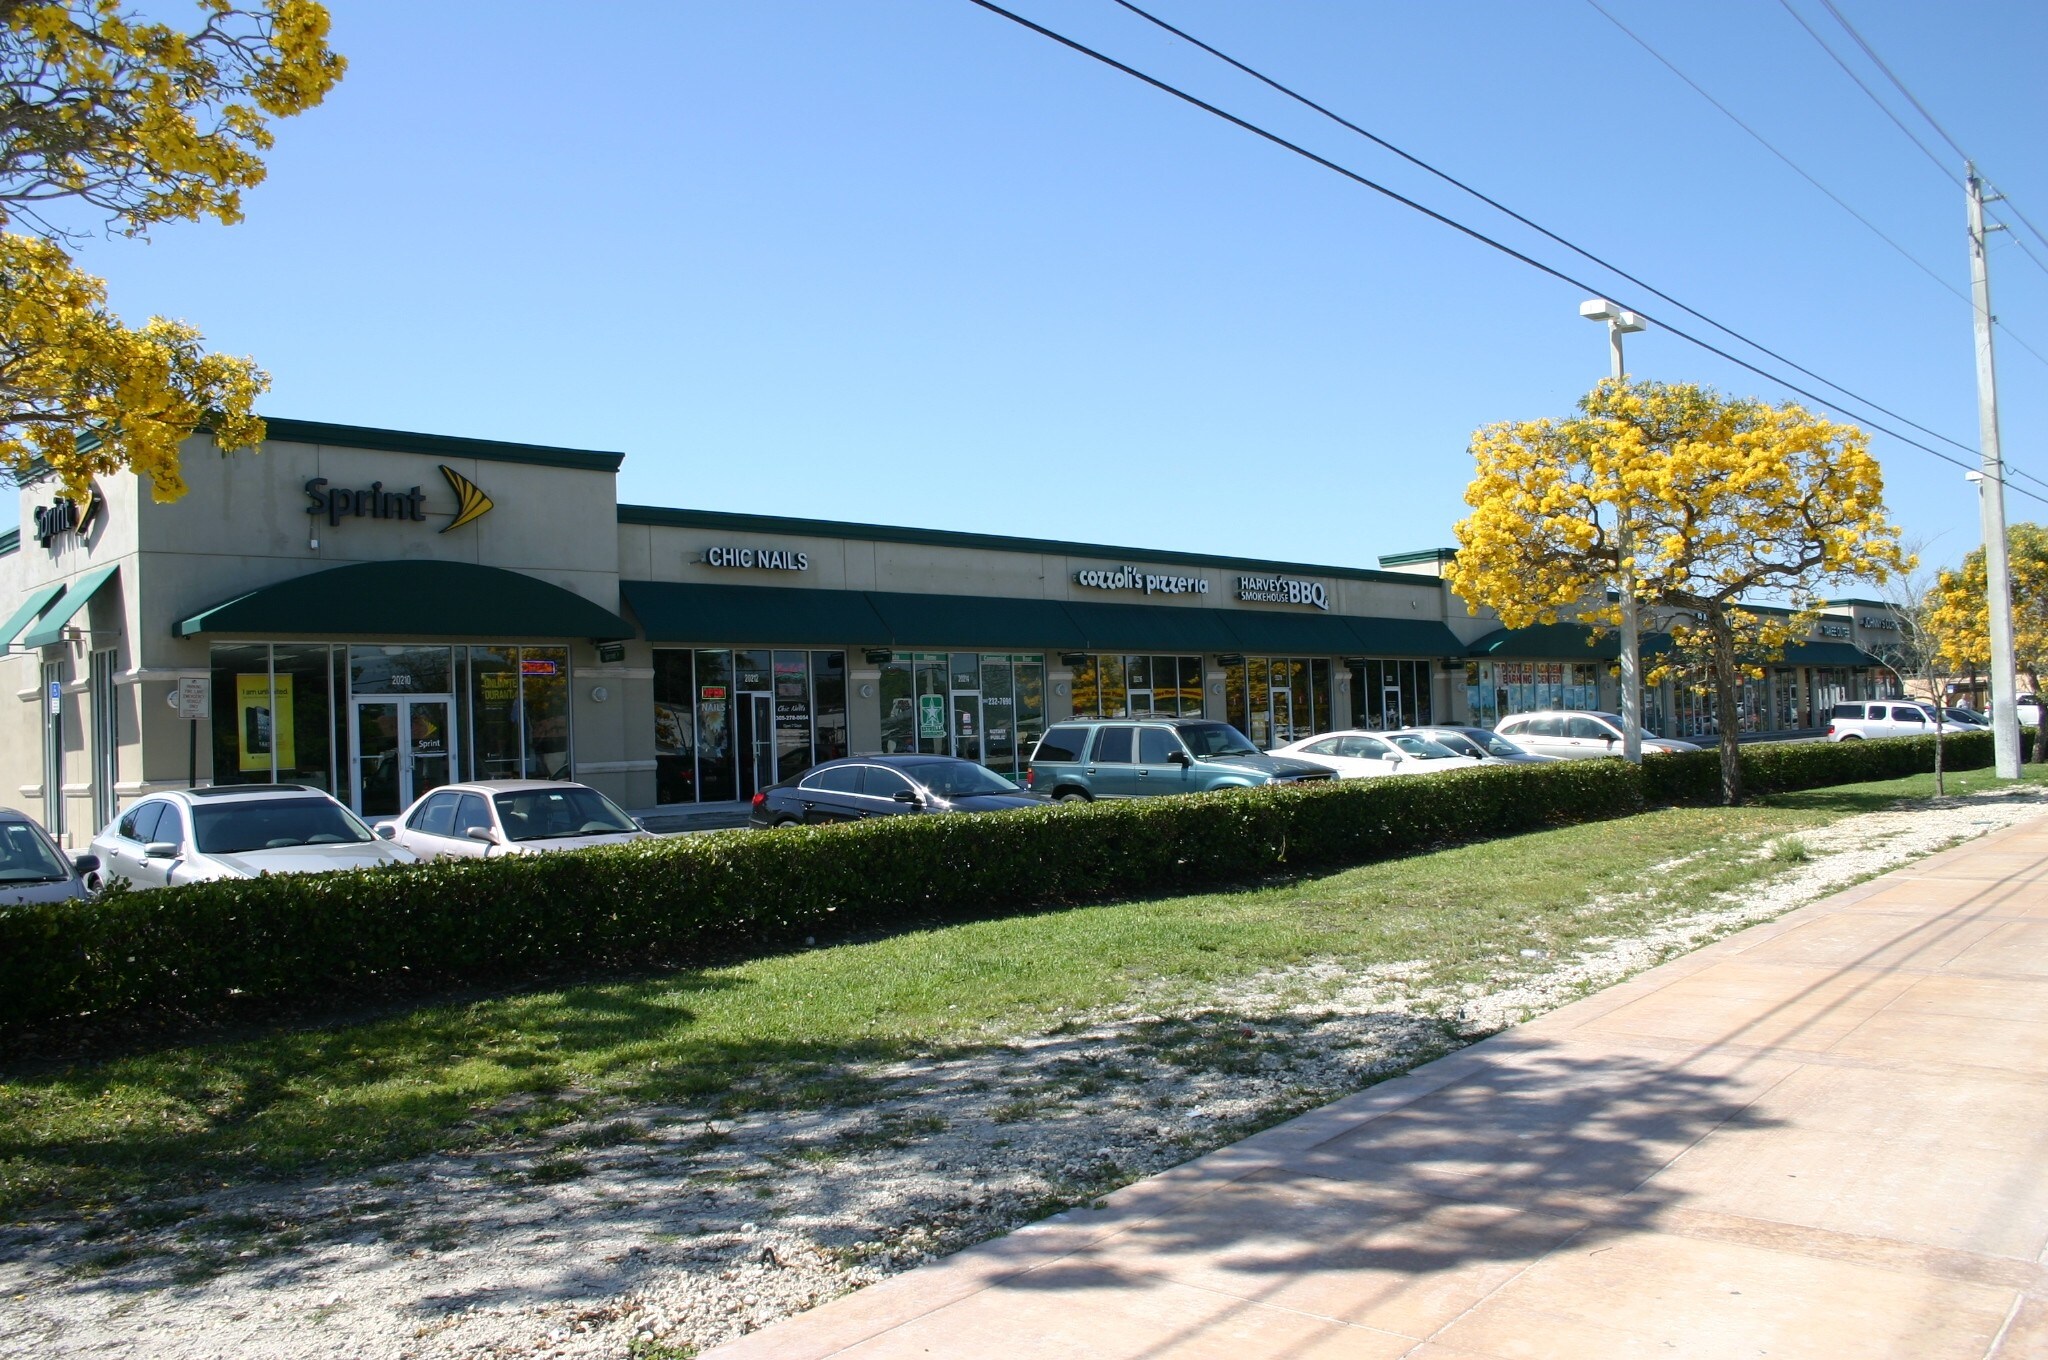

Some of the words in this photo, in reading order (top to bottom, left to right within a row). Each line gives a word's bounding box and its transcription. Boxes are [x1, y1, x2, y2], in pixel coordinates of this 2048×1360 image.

[305, 477, 426, 527] Sprint
[34, 497, 72, 548] Sprint
[707, 547, 752, 568] CHIC
[756, 550, 808, 571] NAILS
[1080, 565, 1143, 590] cozzoli's
[1146, 574, 1209, 595] pizzeria
[1240, 576, 1288, 592] HARVEY'S
[1240, 591, 1288, 603] SMOKEHOUSE
[1288, 581, 1329, 611] BBQ
[391, 675, 412, 685] 20210
[701, 702, 726, 712] NAILS
[418, 739, 441, 749] Sprint
